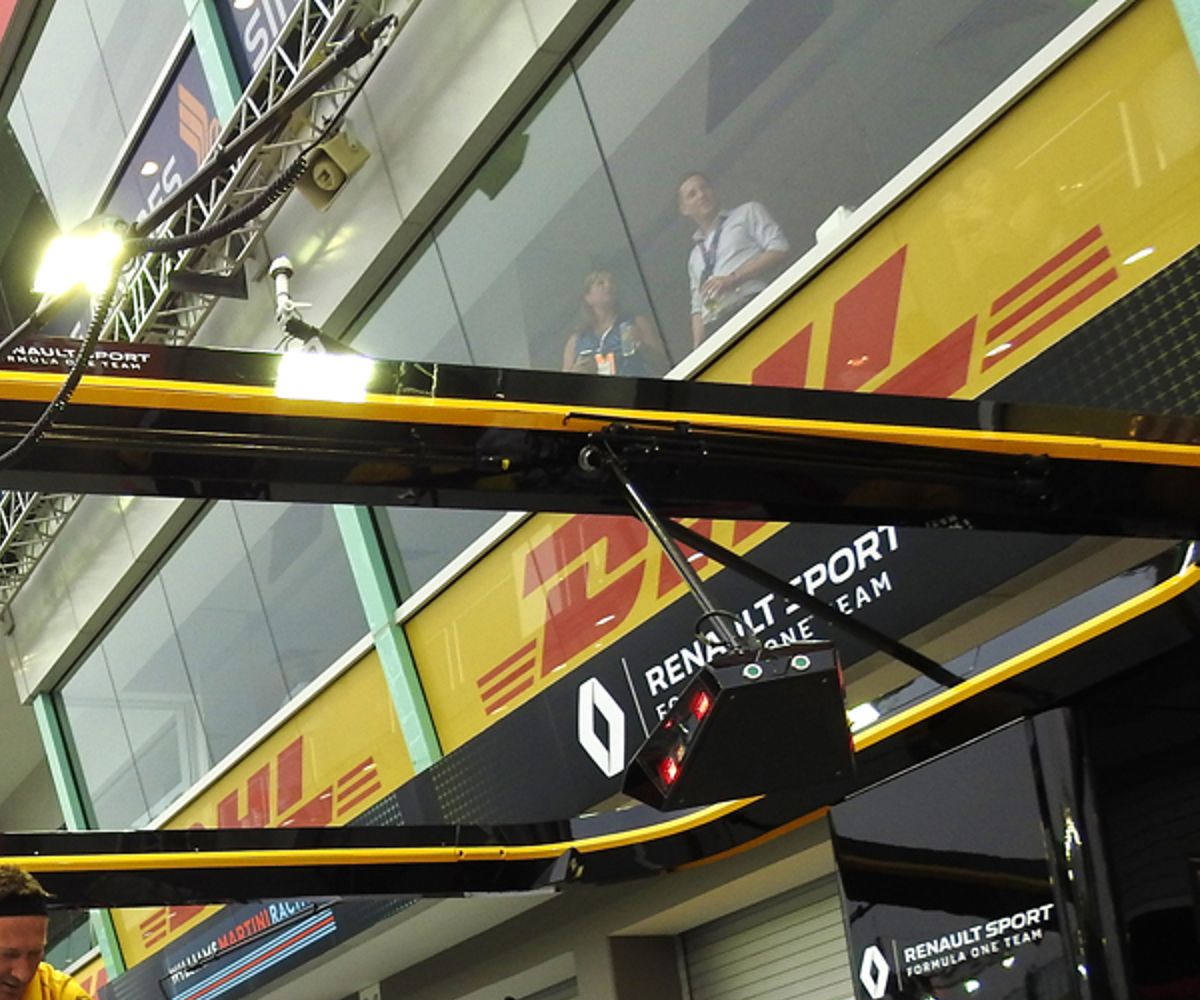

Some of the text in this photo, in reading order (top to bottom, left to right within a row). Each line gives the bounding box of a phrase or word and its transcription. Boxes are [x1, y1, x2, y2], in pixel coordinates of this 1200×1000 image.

[6, 355, 59, 366] RMULA
[67, 359, 94, 369] OE
[85, 351, 151, 363] PORT
[834, 570, 894, 616] EAM
[217, 908, 271, 950] MARTINI
[903, 903, 1054, 963] RENAULT SPORT
[907, 928, 1043, 977] FORMULA ONE TEAM
